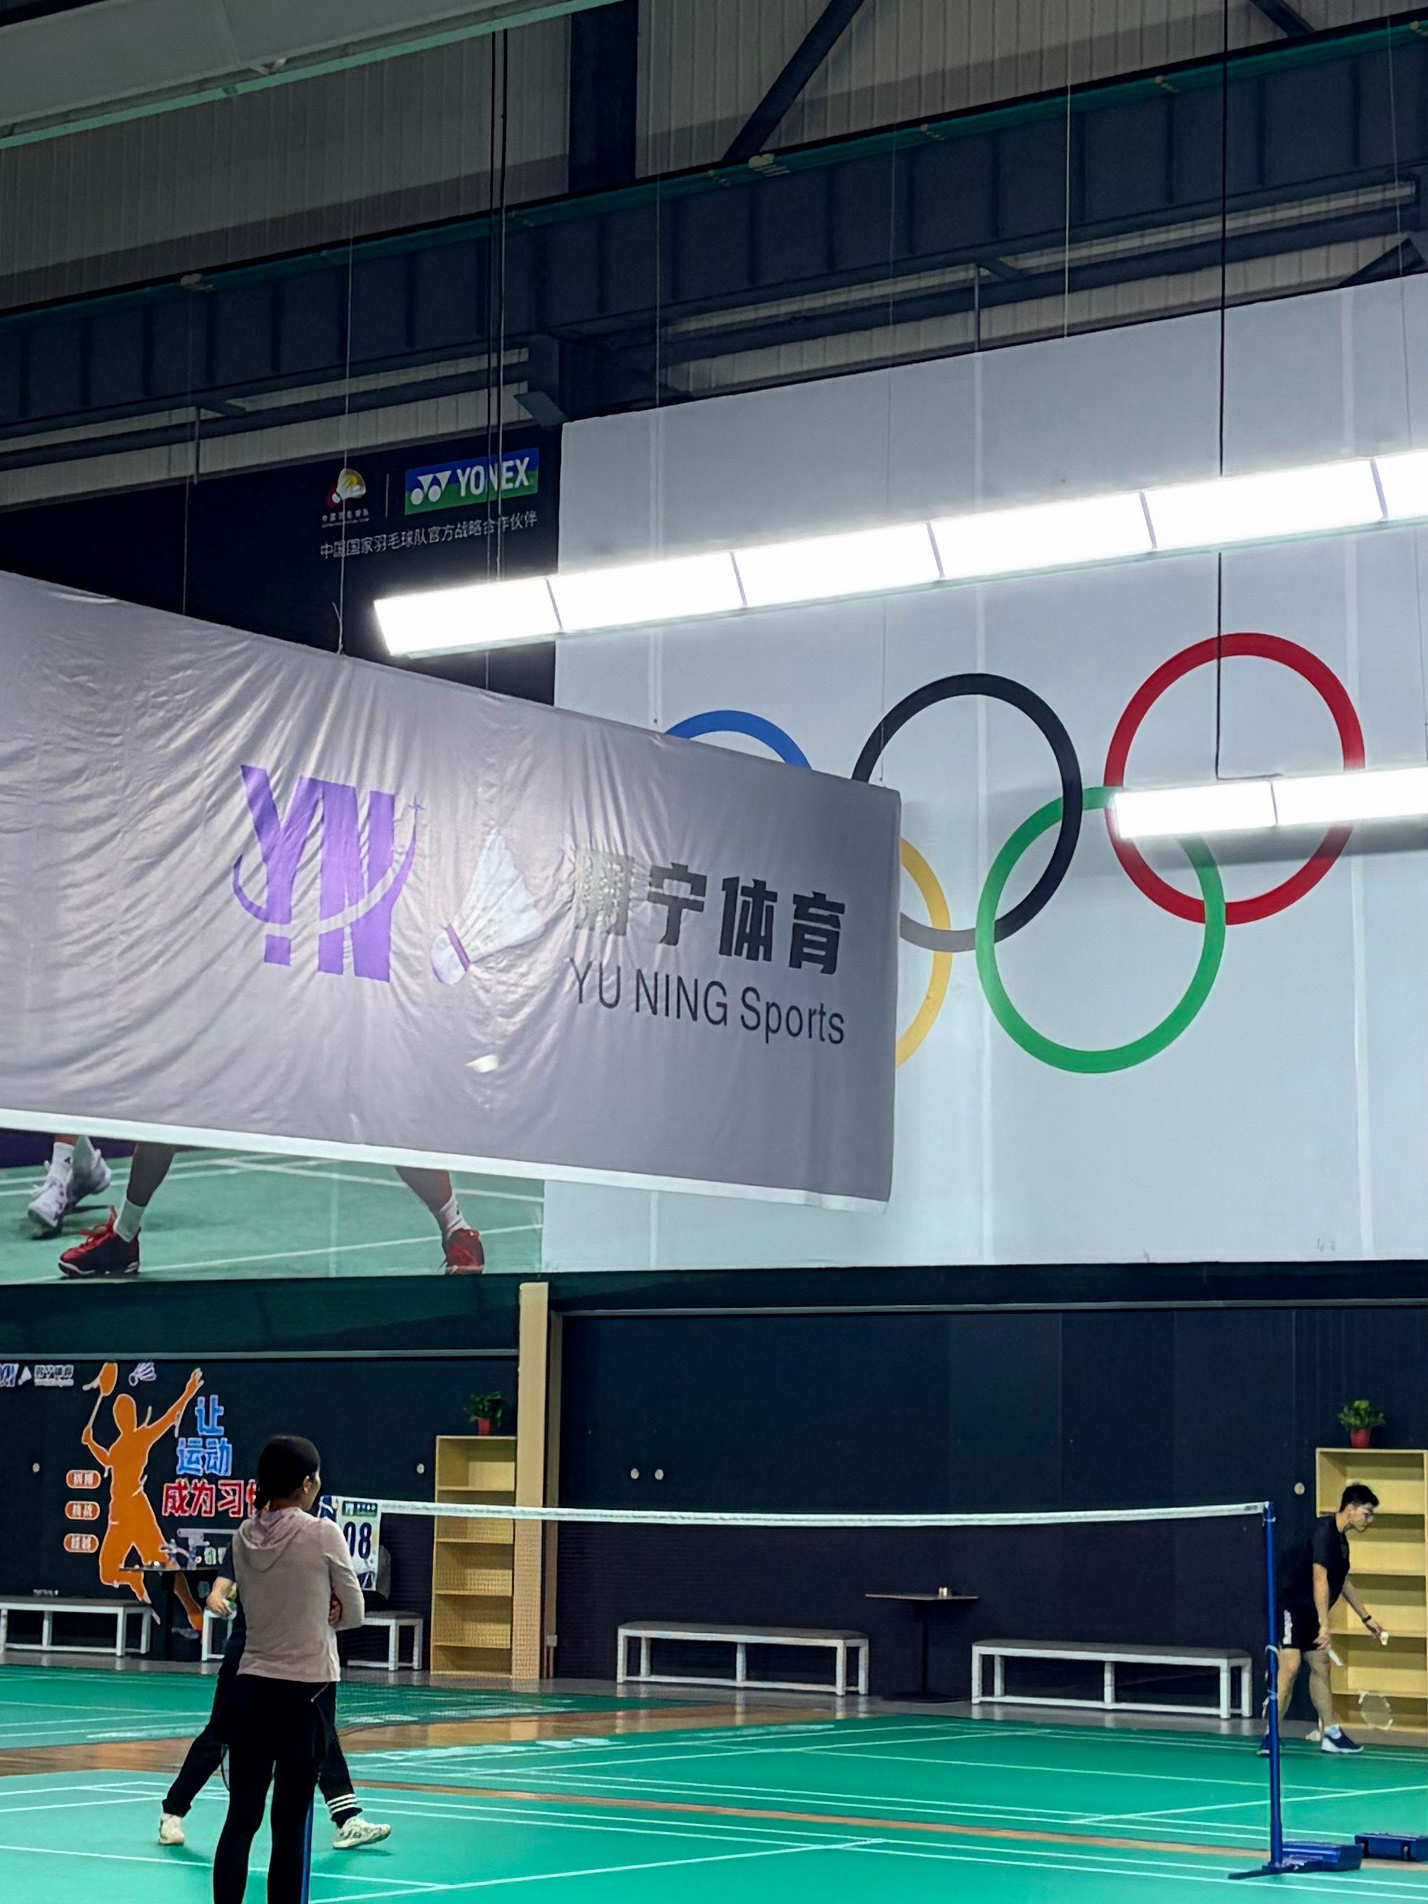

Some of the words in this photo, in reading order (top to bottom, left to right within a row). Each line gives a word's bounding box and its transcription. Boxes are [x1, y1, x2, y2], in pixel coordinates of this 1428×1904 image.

[456, 456, 530, 497] YONEX
[570, 957, 621, 1009] YU
[635, 967, 728, 1027] NING
[740, 986, 845, 1045] Sports
[195, 1394, 225, 1436] 让
[176, 1437, 233, 1477] 运动
[342, 1521, 373, 1561] 08
